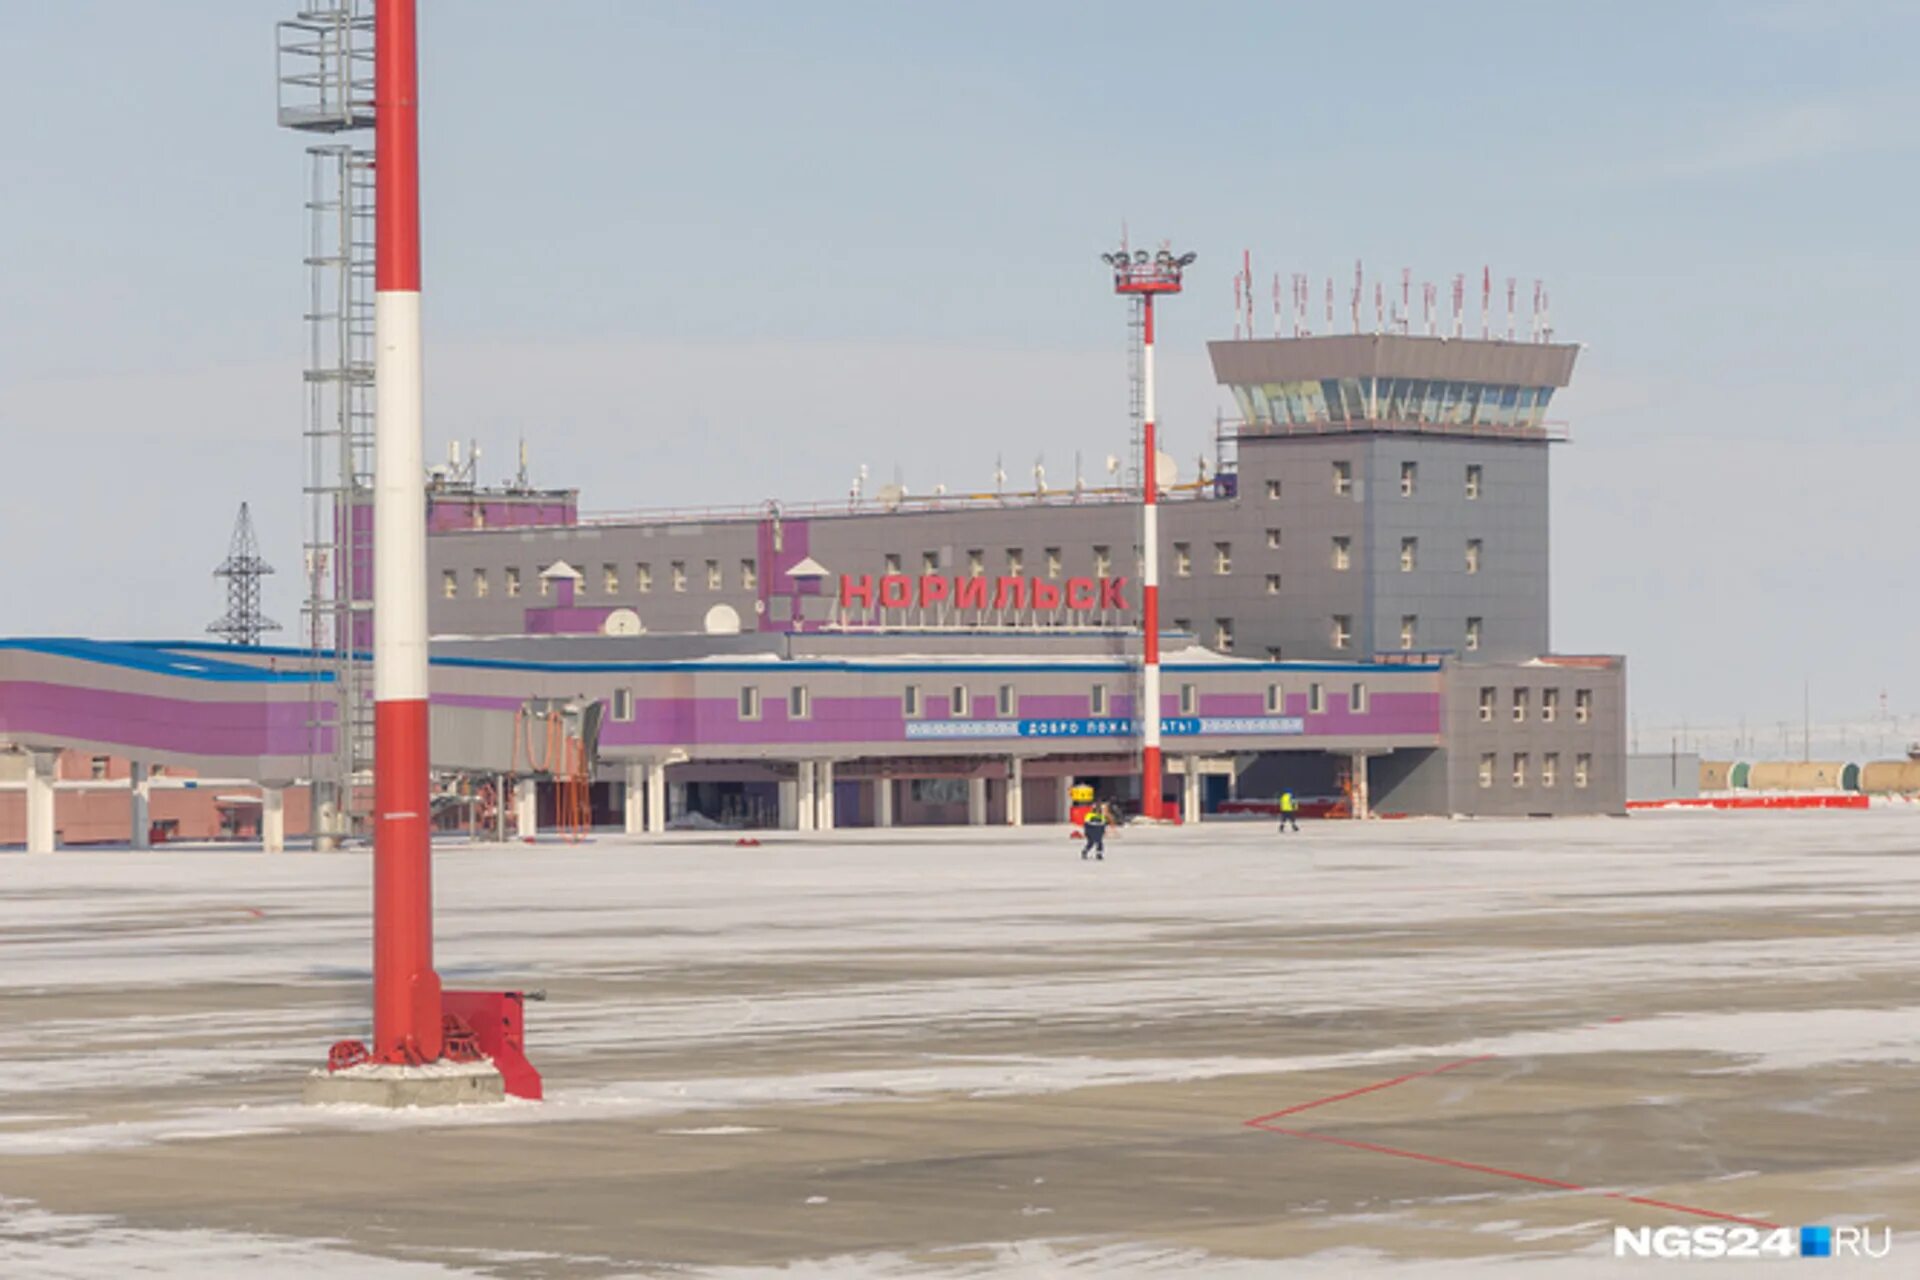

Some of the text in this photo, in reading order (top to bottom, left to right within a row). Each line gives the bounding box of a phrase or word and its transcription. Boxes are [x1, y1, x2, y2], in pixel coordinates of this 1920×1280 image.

[840, 574, 1130, 609] НОРИЛЬСК
[1028, 720, 1193, 734] ДОБРО ПОЖААТЬ!
